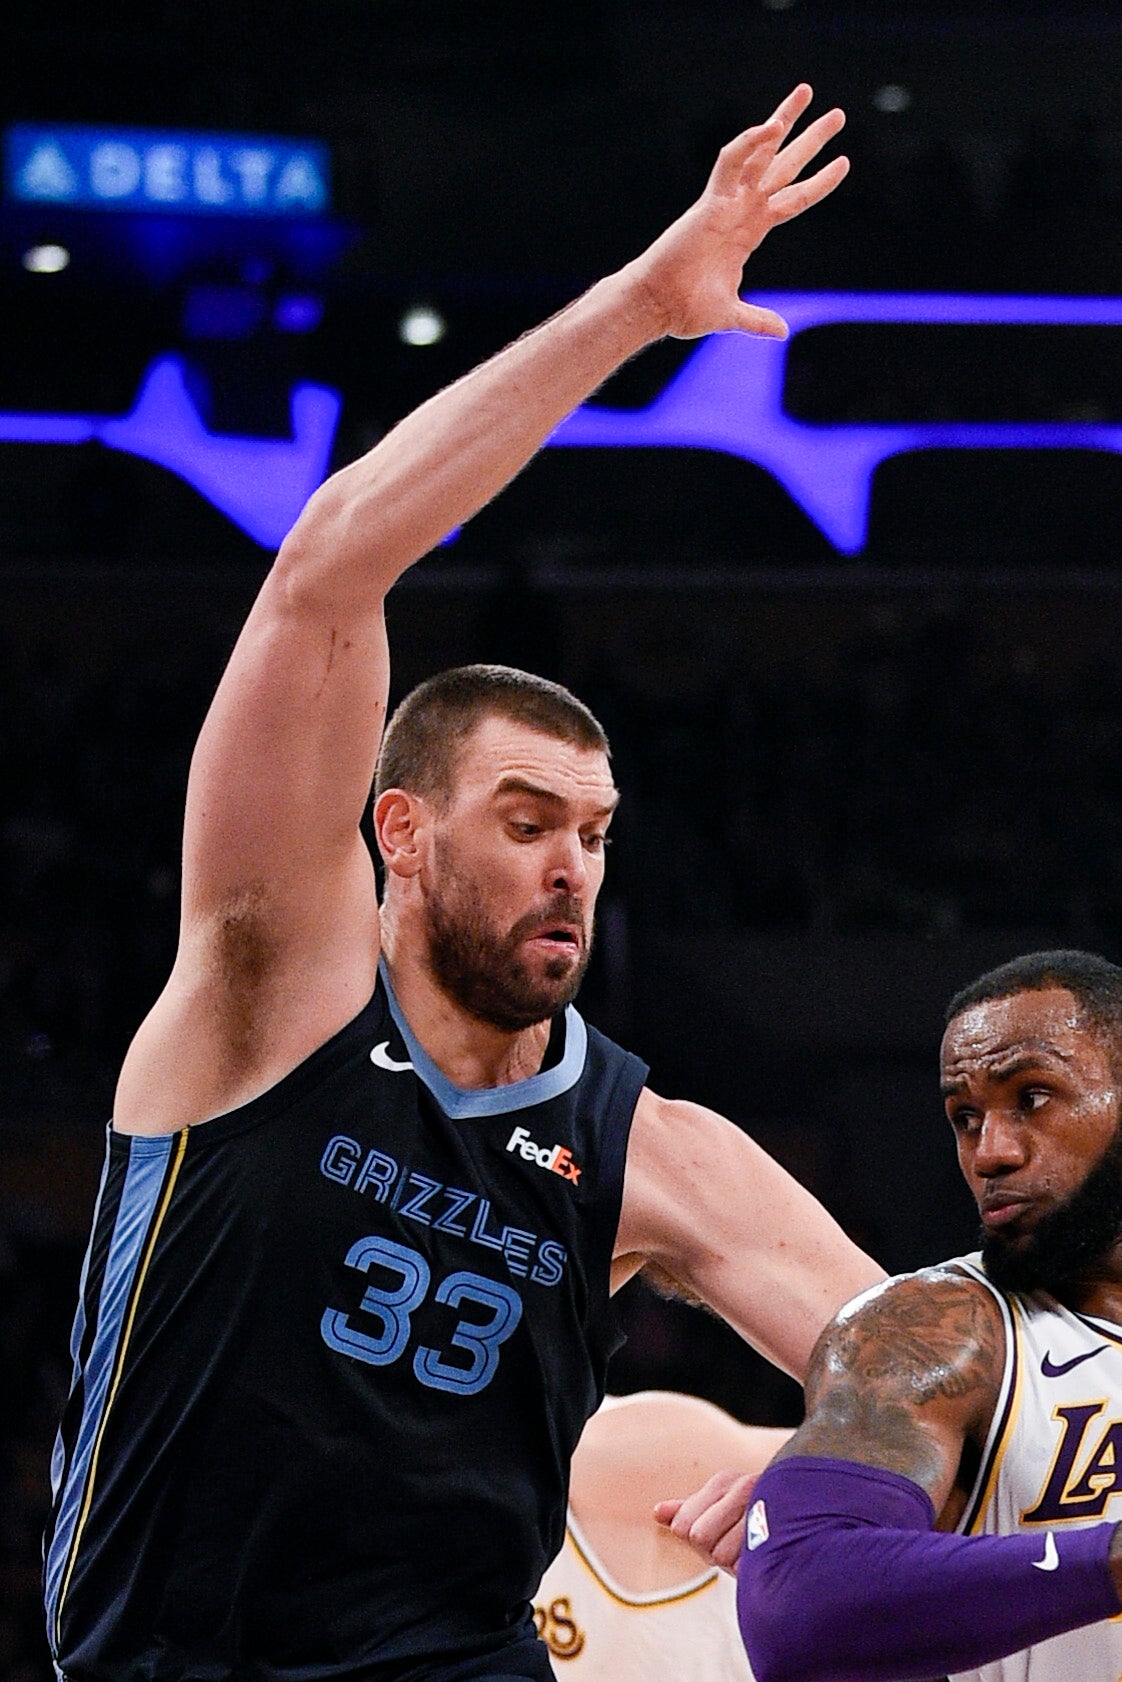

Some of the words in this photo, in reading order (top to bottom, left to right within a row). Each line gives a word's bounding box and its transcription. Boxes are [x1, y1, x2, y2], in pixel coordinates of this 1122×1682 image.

[89, 142, 326, 207] DELTA
[506, 1126, 582, 1186] FedEx
[320, 1235, 523, 1395] 33
